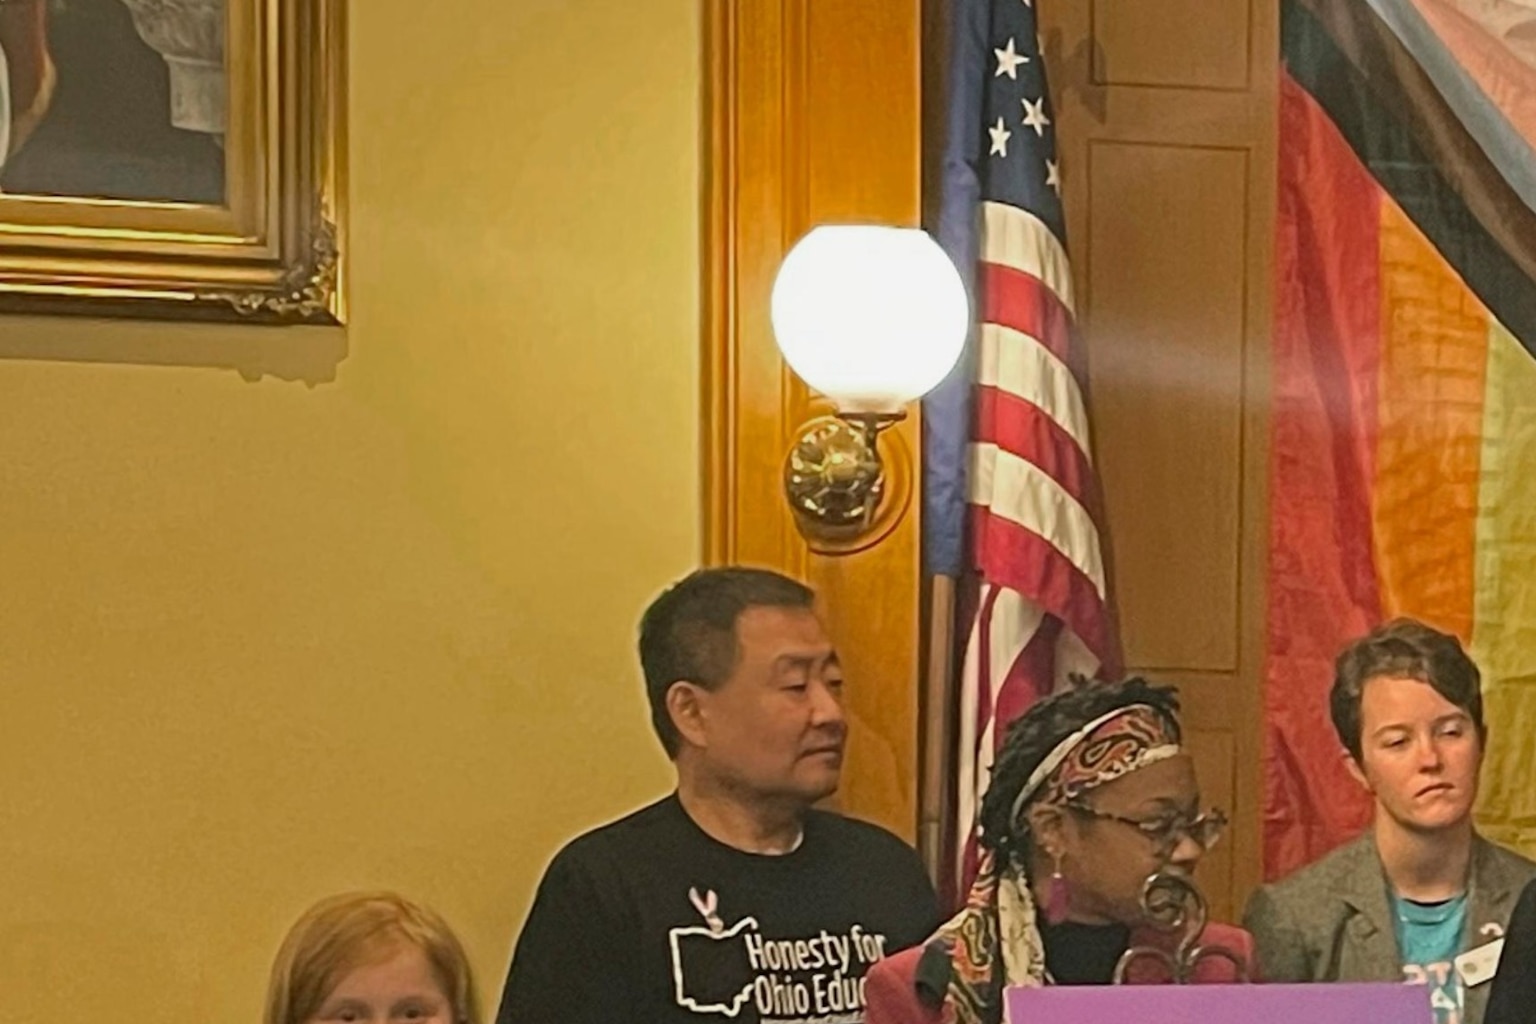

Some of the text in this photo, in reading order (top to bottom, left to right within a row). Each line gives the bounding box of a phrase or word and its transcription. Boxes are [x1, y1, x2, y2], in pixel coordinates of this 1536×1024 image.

[745, 924, 887, 974] Honesty for
[754, 973, 809, 1016] Ohio
